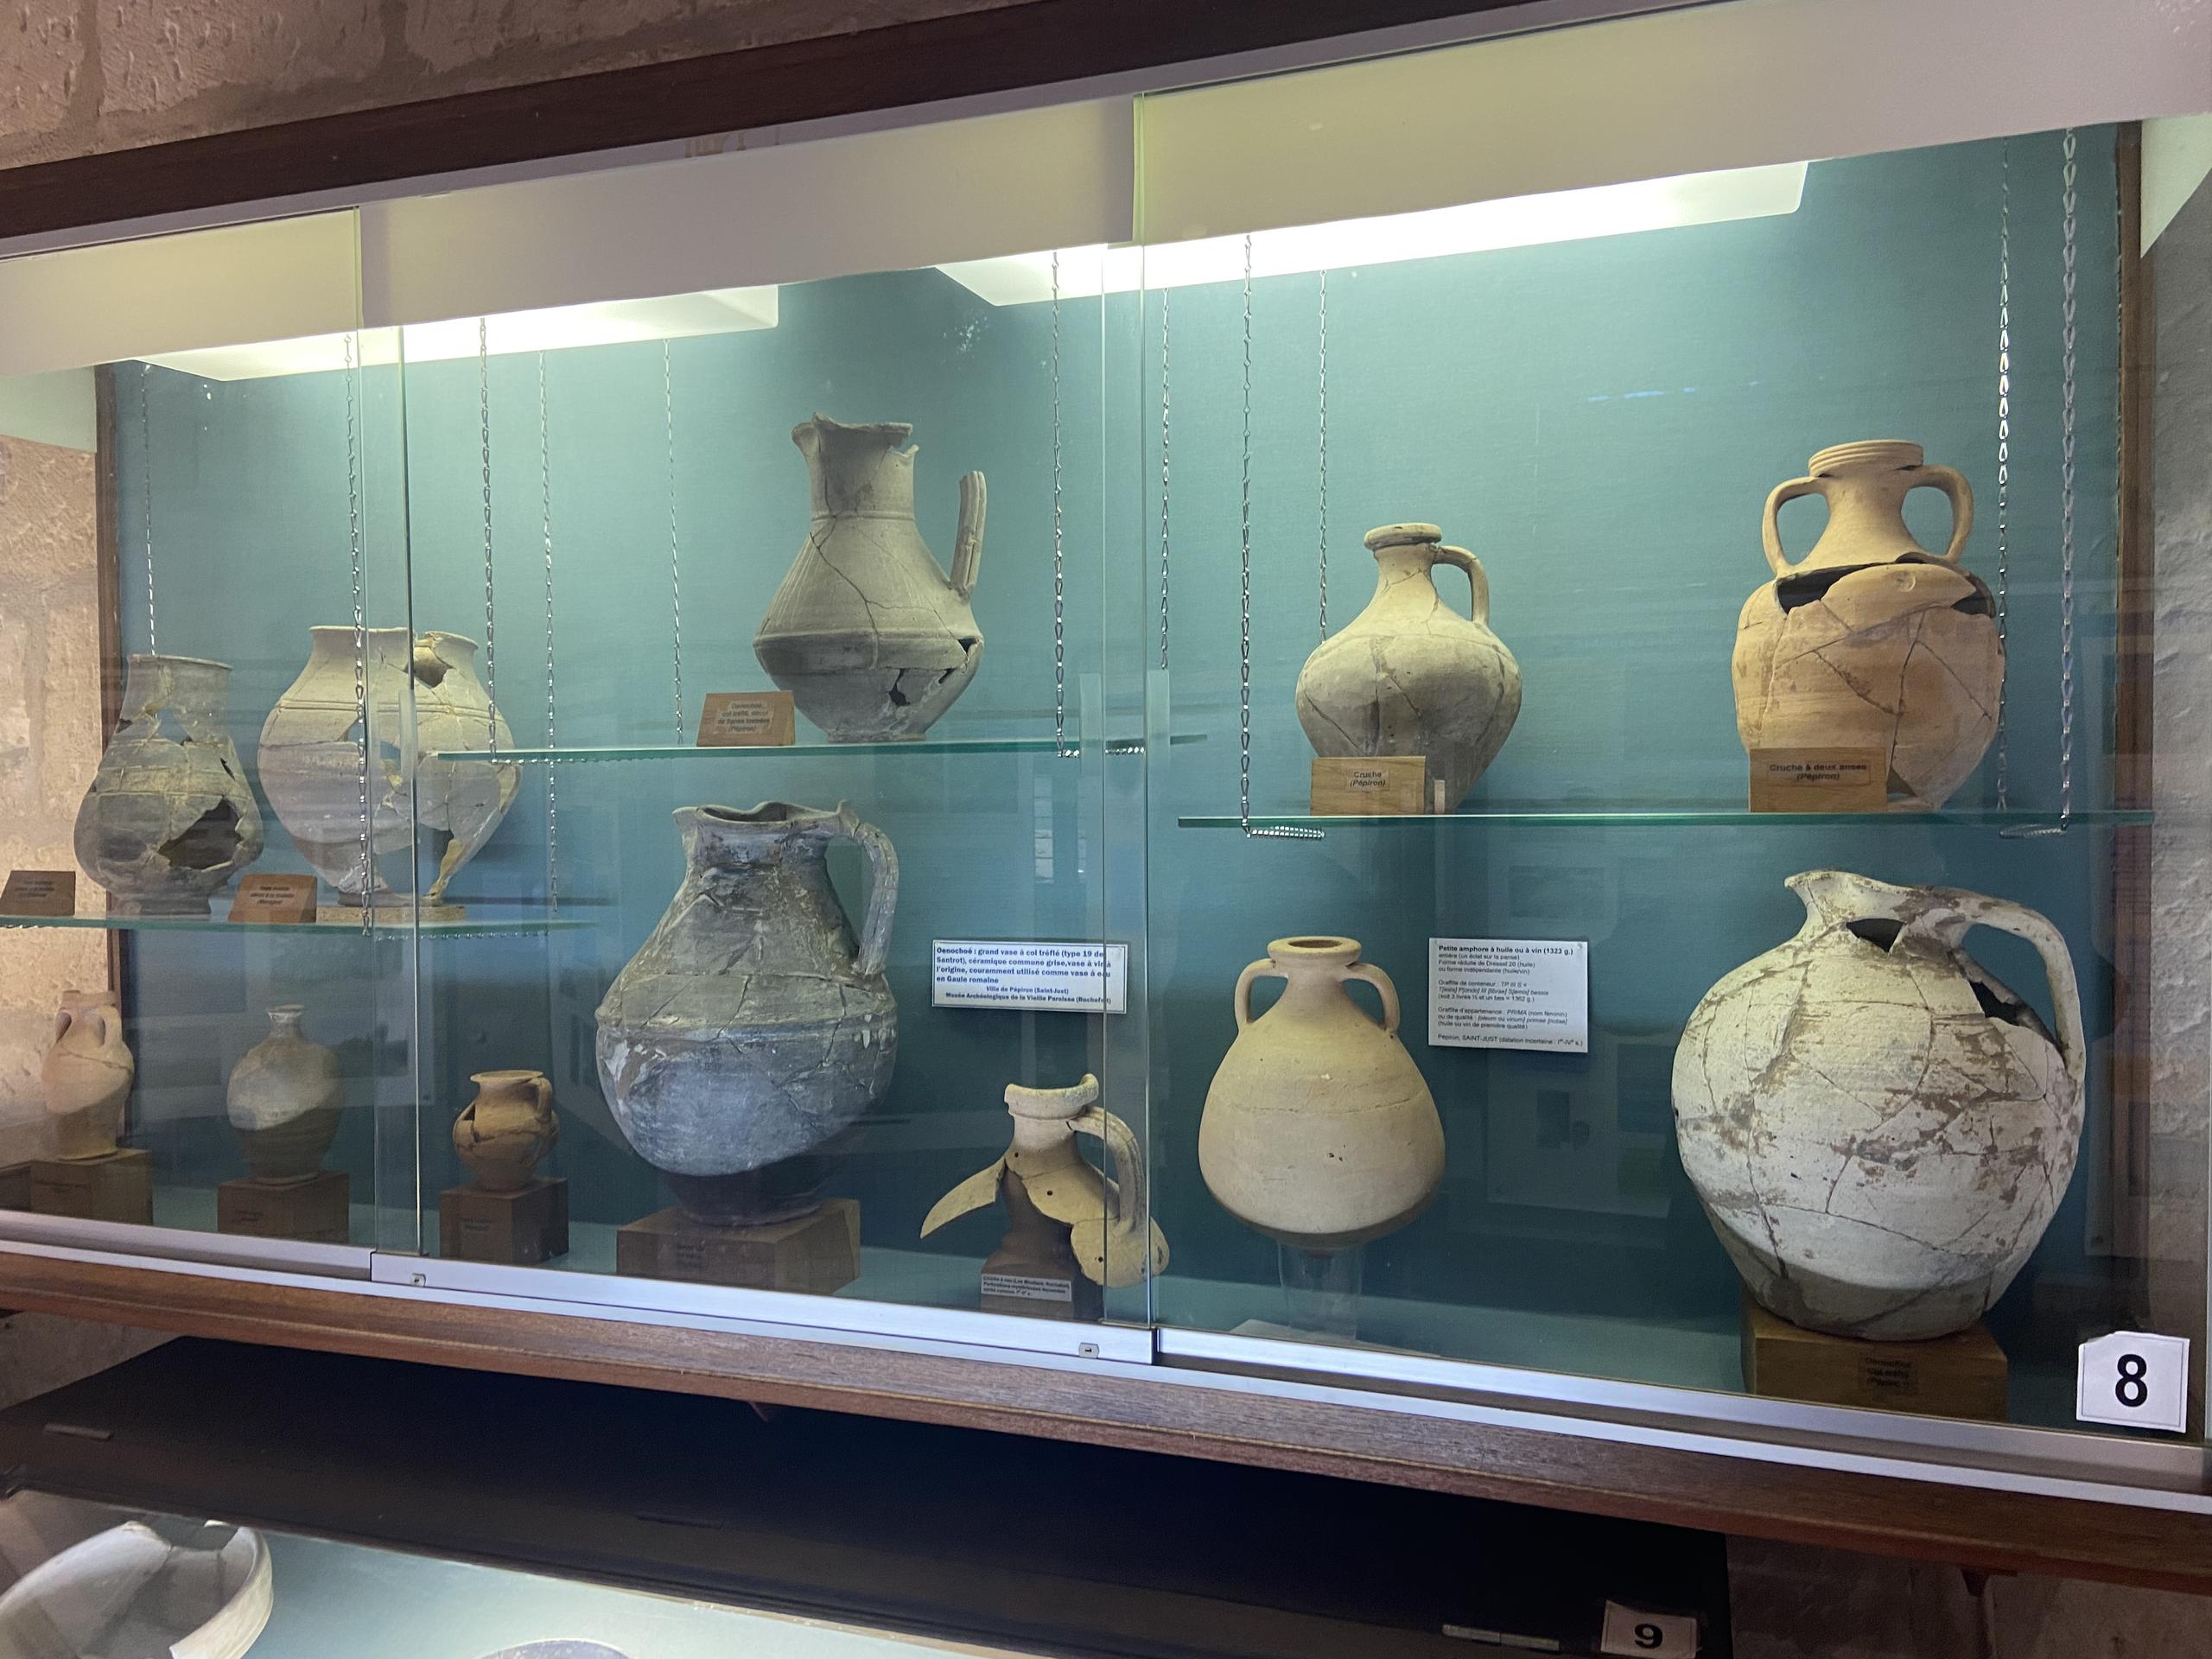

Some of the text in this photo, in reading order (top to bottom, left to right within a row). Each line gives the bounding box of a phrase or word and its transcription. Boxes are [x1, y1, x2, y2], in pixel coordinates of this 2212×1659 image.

[1350, 779, 1386, 787] (Pépiron)
[2115, 1353, 2148, 1407] 8
[1635, 1624, 1662, 1649] 9
